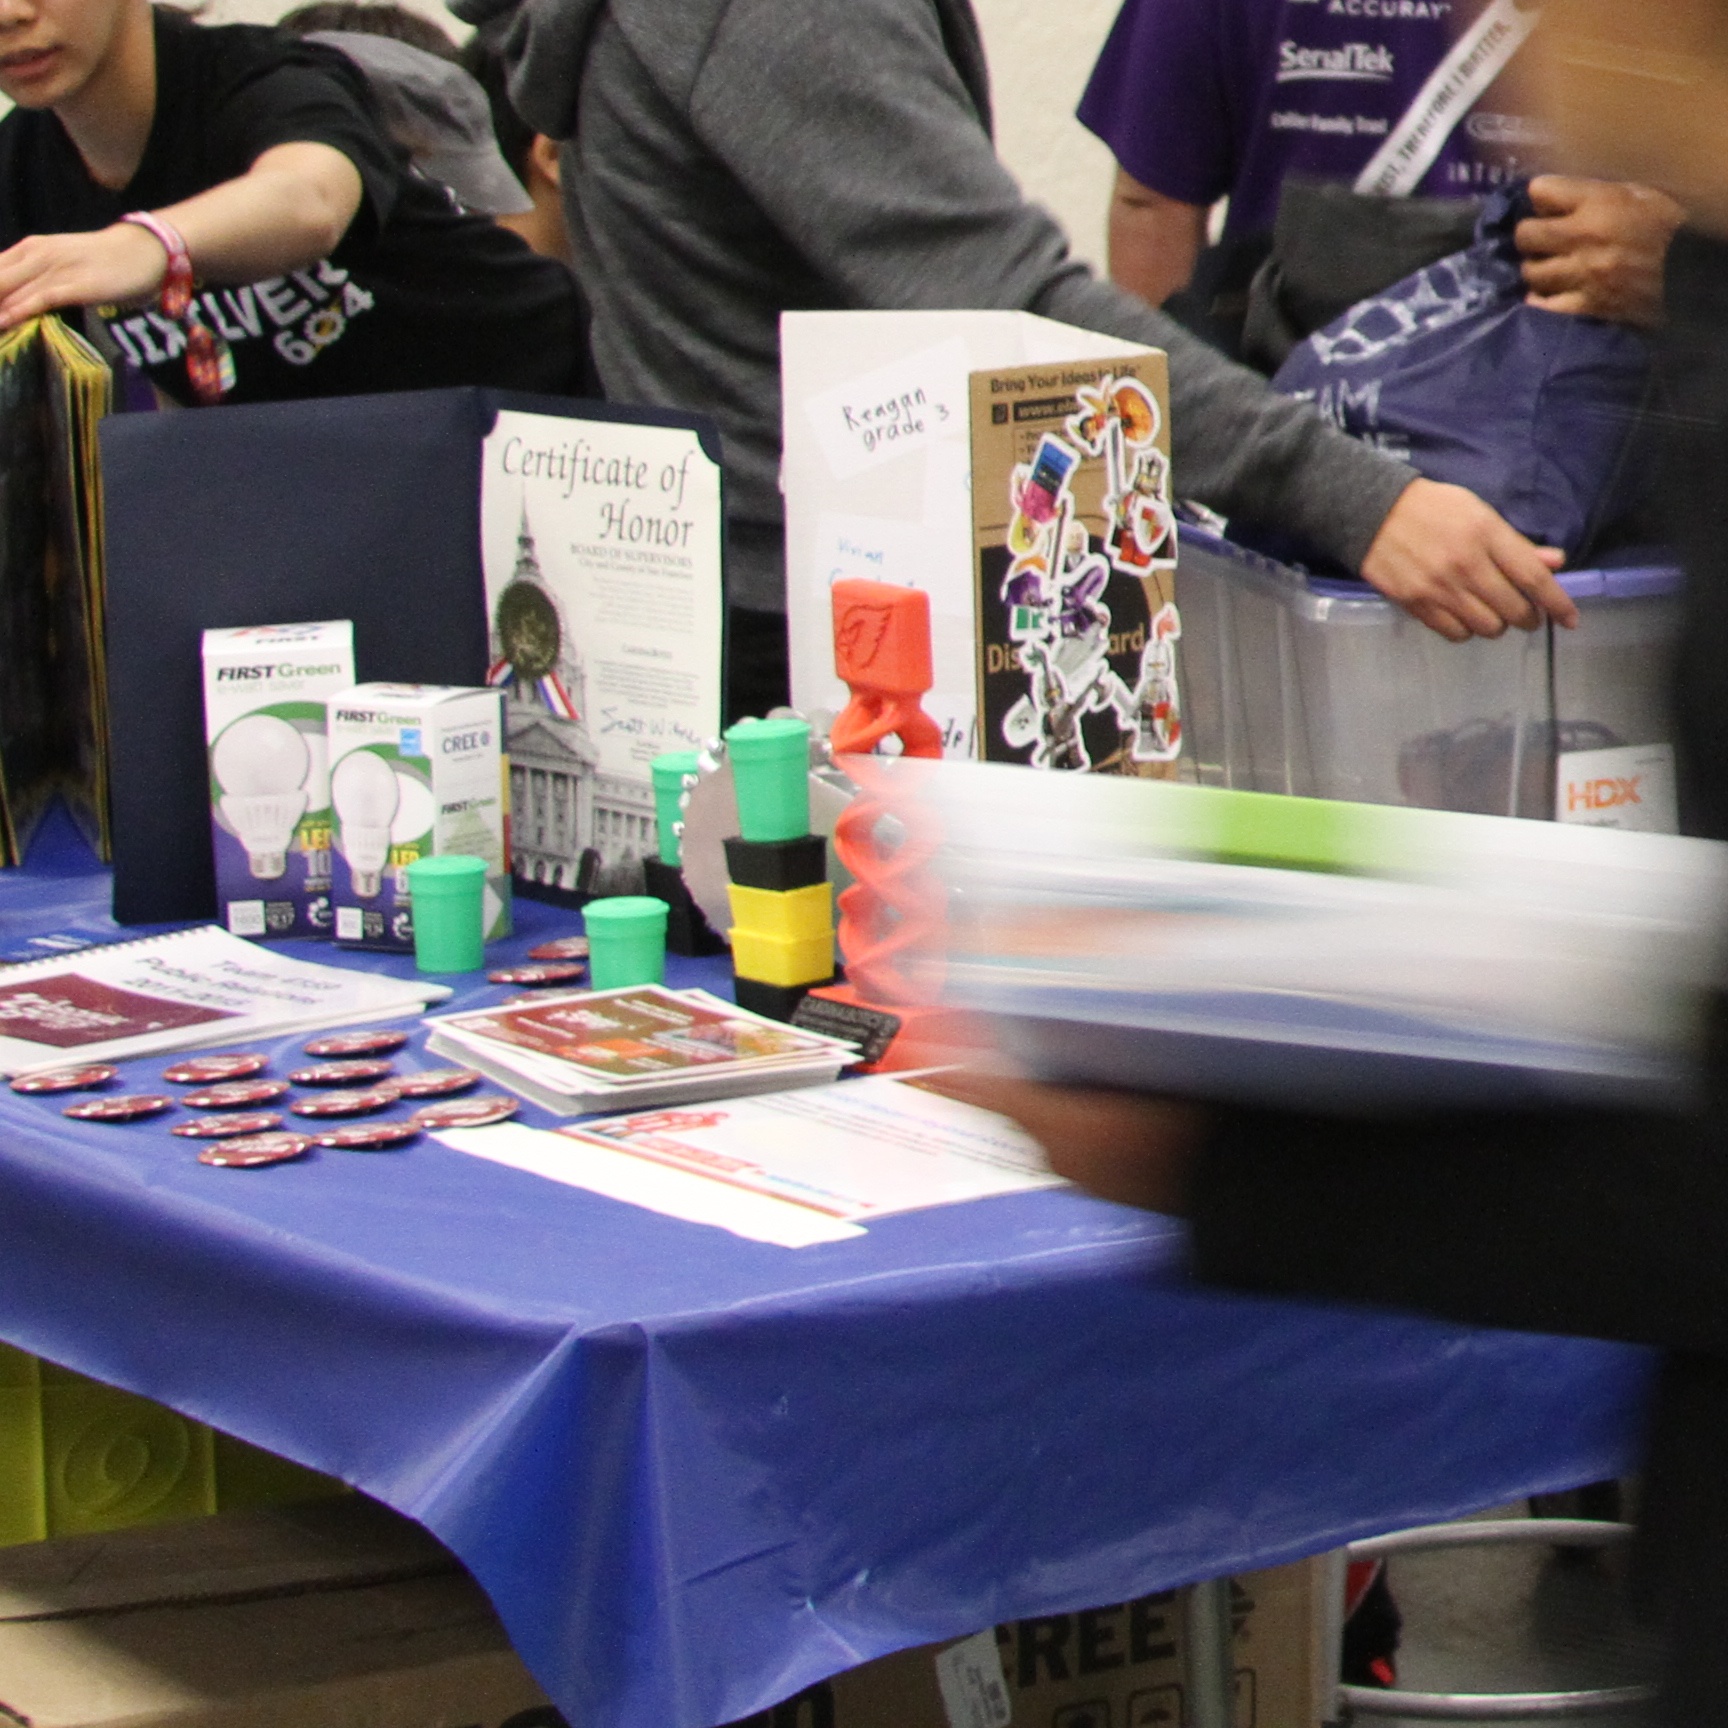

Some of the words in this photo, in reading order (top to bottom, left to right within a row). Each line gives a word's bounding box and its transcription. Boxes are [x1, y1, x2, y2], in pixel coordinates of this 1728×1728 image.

[273, 280, 376, 366] 604
[990, 377, 1026, 394] Bring
[1028, 373, 1059, 389] Your
[1061, 369, 1097, 385] Ideas
[842, 386, 927, 432] Reagan
[863, 396, 925, 453] grade
[934, 402, 950, 422] 3
[502, 436, 649, 500] Certificate
[660, 449, 695, 512] of
[600, 498, 694, 548] Honor
[216, 664, 275, 682] FIRST
[336, 709, 377, 723] FIRST
[442, 731, 479, 755] CREE
[1567, 775, 1643, 812] HDX
